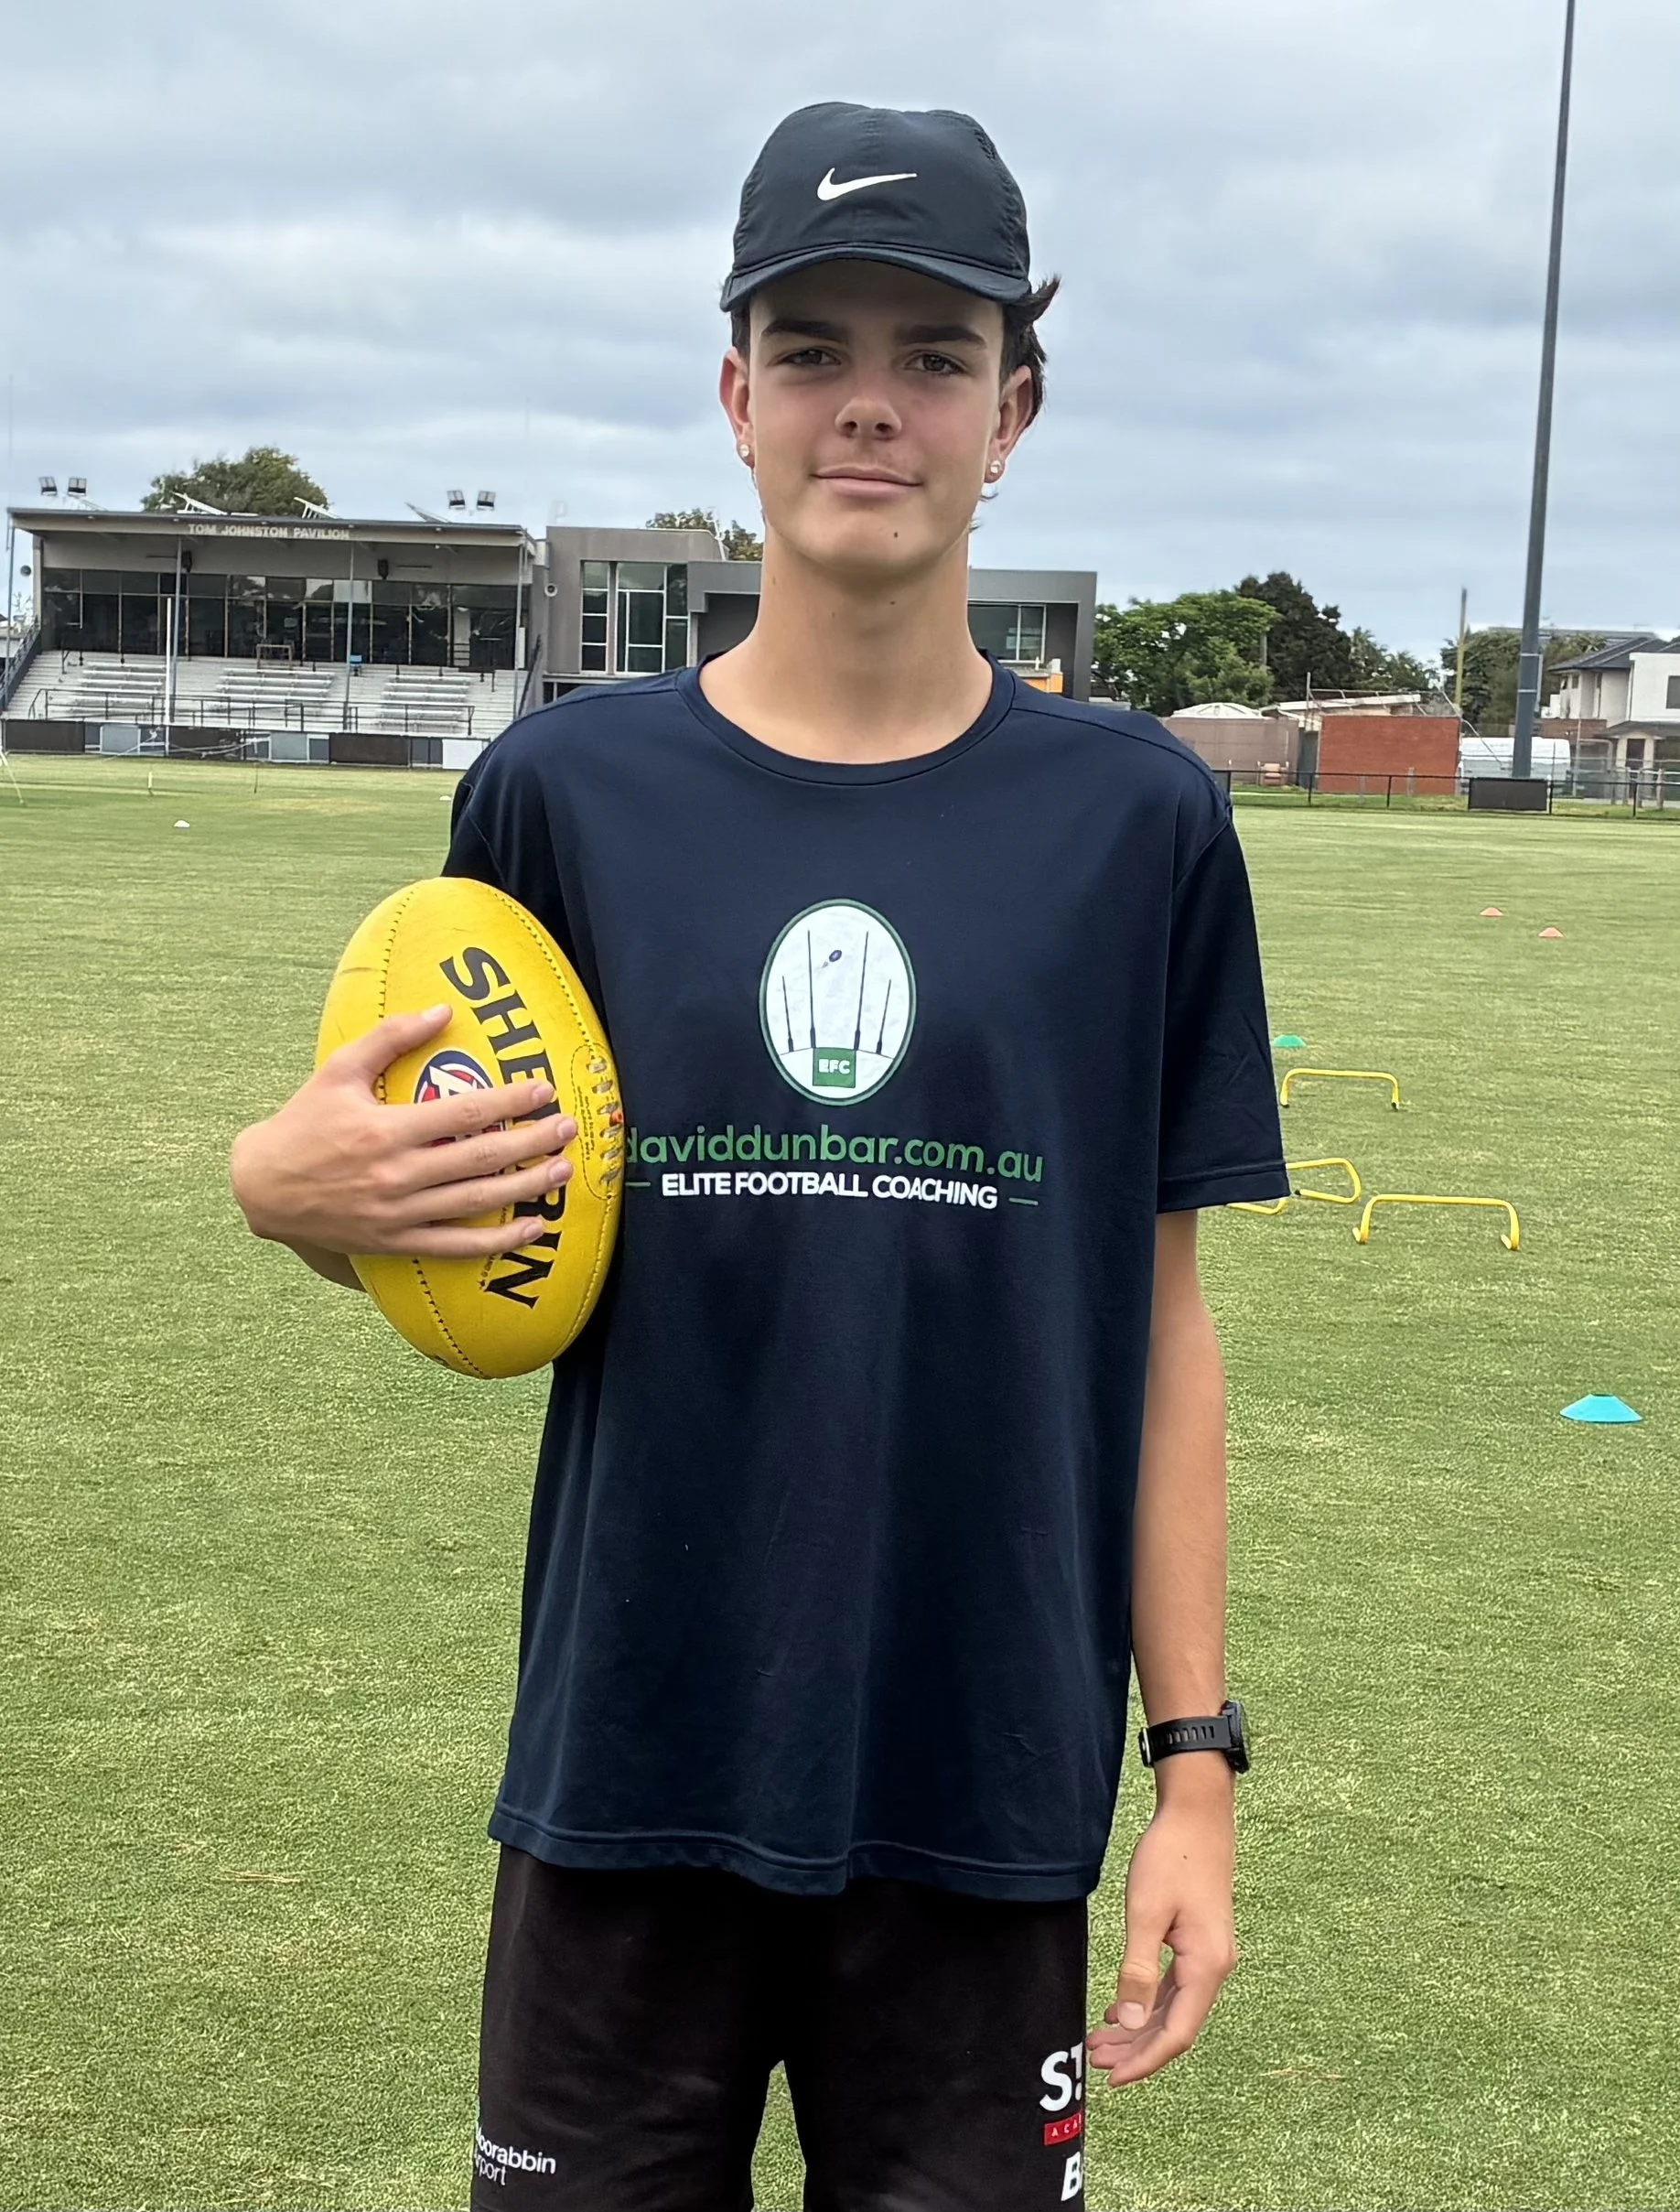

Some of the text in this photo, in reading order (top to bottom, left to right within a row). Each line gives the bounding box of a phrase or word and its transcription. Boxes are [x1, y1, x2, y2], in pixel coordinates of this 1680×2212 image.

[188, 523, 350, 541] TOM JOHNSTON PAVILION
[819, 1058, 851, 1074] EFC
[627, 1124, 1043, 1182] daviddunbar.com.au
[662, 1172, 997, 1209] ELITE FOOTBALL COACHING
